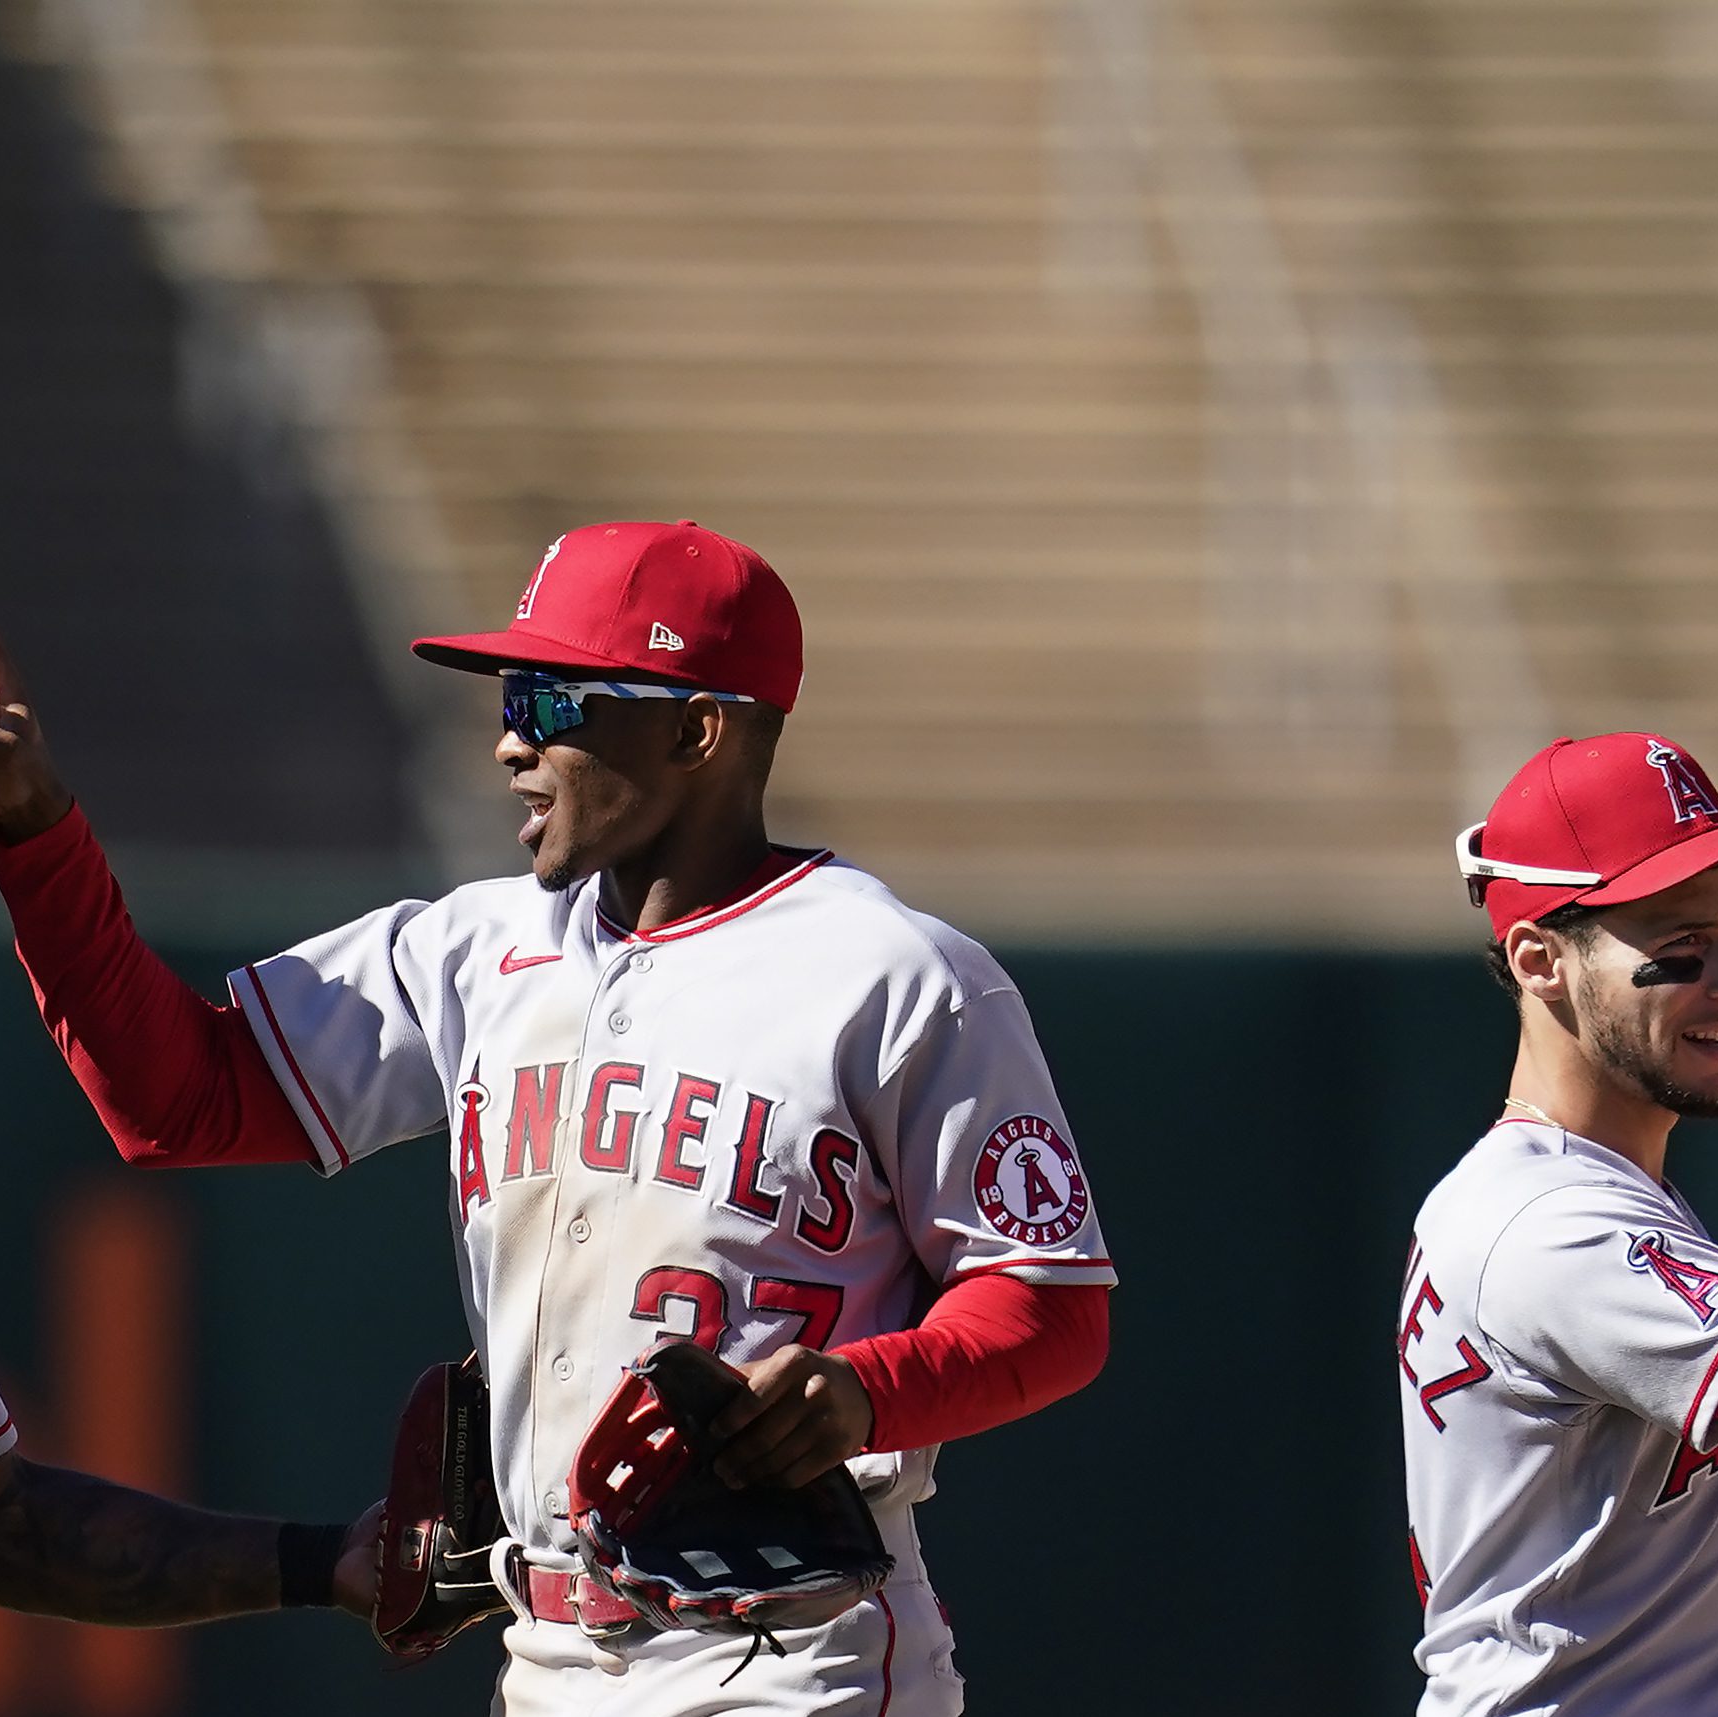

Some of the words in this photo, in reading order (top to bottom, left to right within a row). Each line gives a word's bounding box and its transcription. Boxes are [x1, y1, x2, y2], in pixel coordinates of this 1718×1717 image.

[1646, 740, 1718, 824] A
[456, 1052, 862, 1257] ANGELS
[986, 1119, 1053, 1161] ANGELS
[981, 1184, 1002, 1206] 19
[1014, 1142, 1064, 1219] A
[993, 1189, 1085, 1243] BASEBALL
